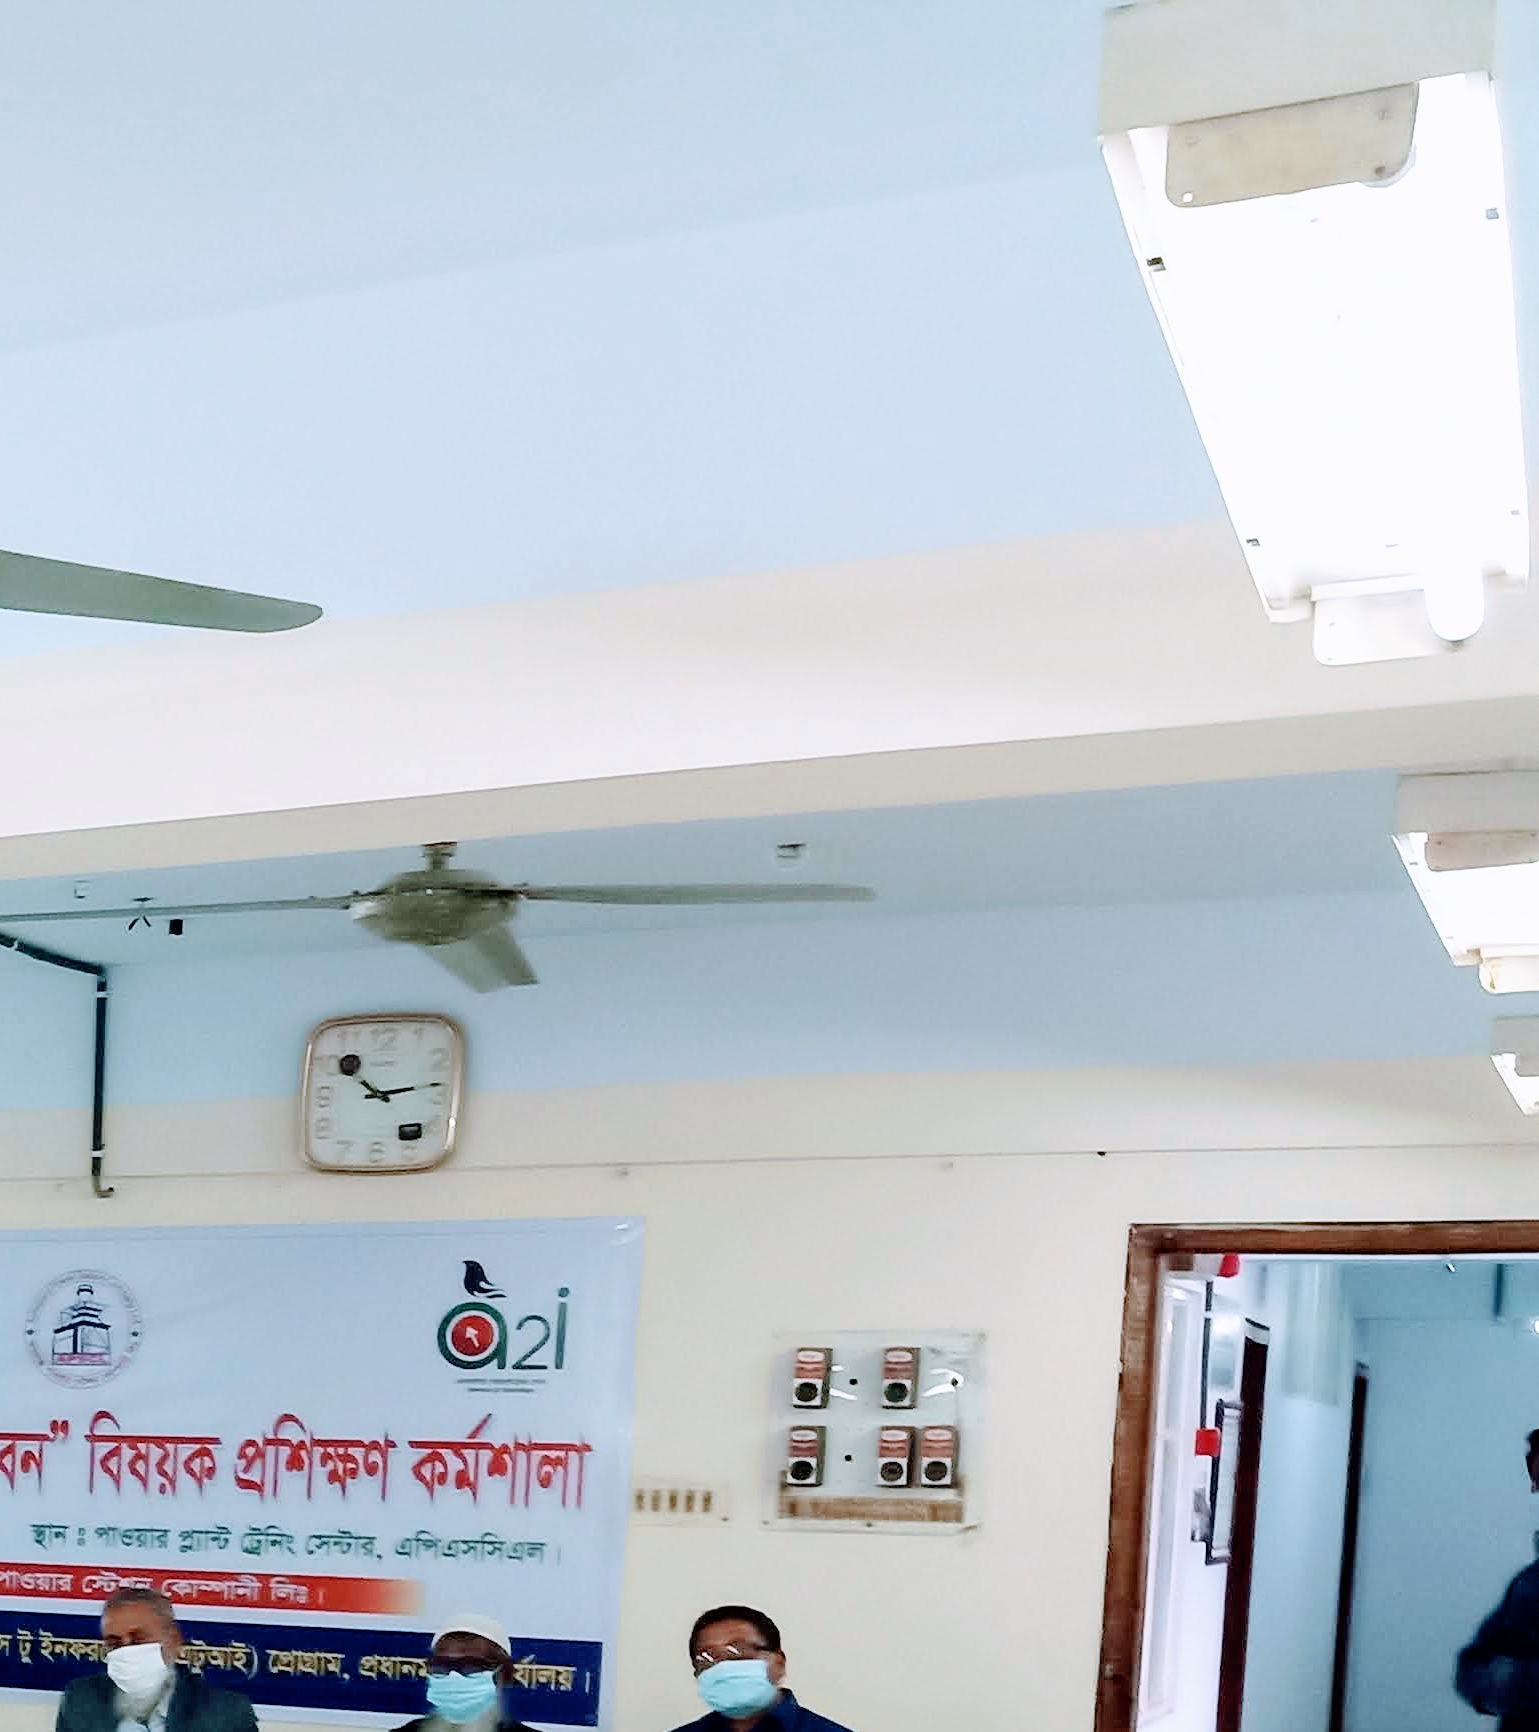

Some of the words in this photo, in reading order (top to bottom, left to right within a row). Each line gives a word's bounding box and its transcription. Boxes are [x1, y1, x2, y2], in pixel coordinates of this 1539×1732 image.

[85, 1410, 221, 1497] বিষয়ক
[234, 1413, 396, 1503] প্রশিক্ষণ
[408, 1413, 593, 1510] কর্মশালা
[30, 1523, 69, 1550] স্থান
[93, 1526, 171, 1550] পাওয়ার
[240, 1525, 296, 1556] ট্রেনিং
[395, 1532, 548, 1562] এপিএসসিএল
[16, 1628, 33, 1663] টু
